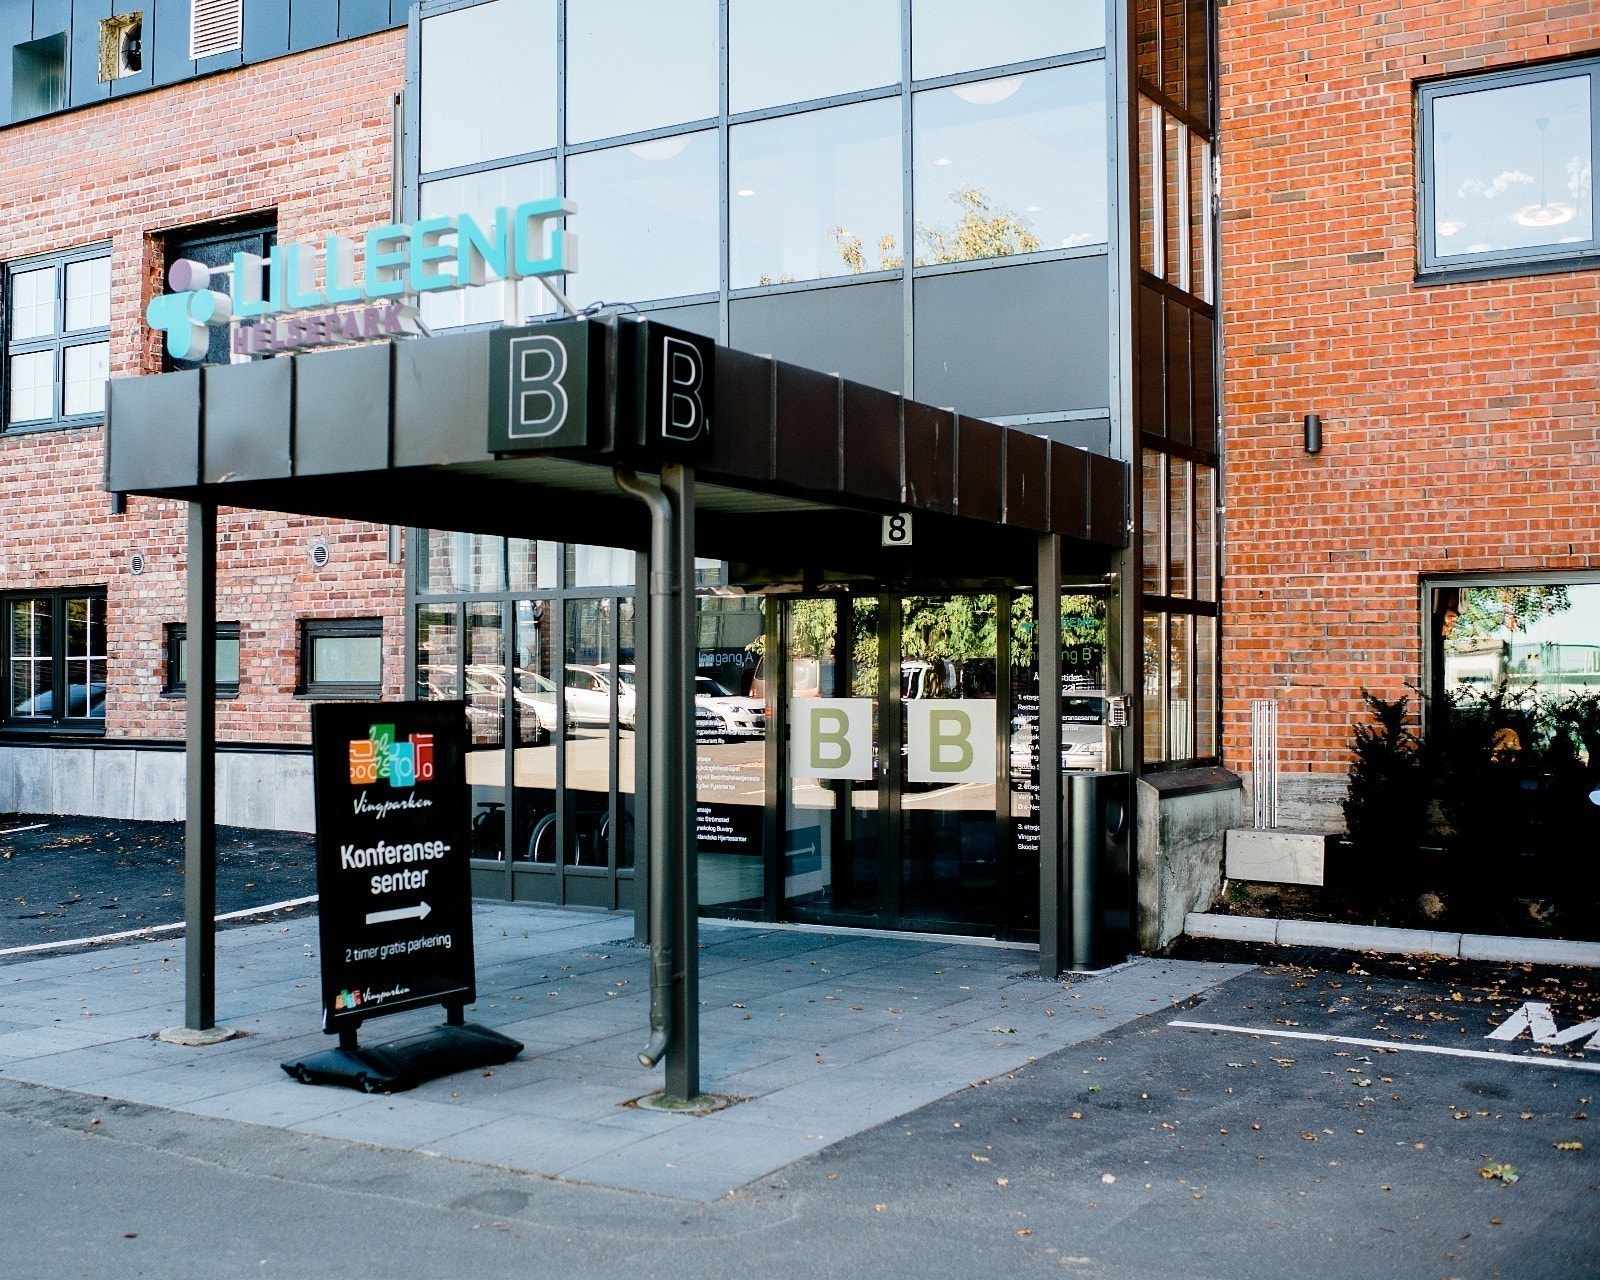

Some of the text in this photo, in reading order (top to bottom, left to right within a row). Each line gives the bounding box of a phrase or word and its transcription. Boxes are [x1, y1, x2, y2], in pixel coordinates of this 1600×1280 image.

[233, 196, 573, 317] LILLEENG
[233, 301, 405, 355] HELSEPARK
[508, 333, 570, 440] B
[661, 335, 704, 442] B
[888, 515, 906, 542] 8
[744, 651, 754, 663] A
[810, 708, 851, 769] B
[929, 709, 974, 773] B
[353, 790, 433, 820] Vingparken
[340, 840, 451, 870] Konferanse-
[370, 868, 429, 894] senter
[345, 934, 452, 962] 2 timer gratis parkering
[362, 984, 411, 1004] Vingparken
